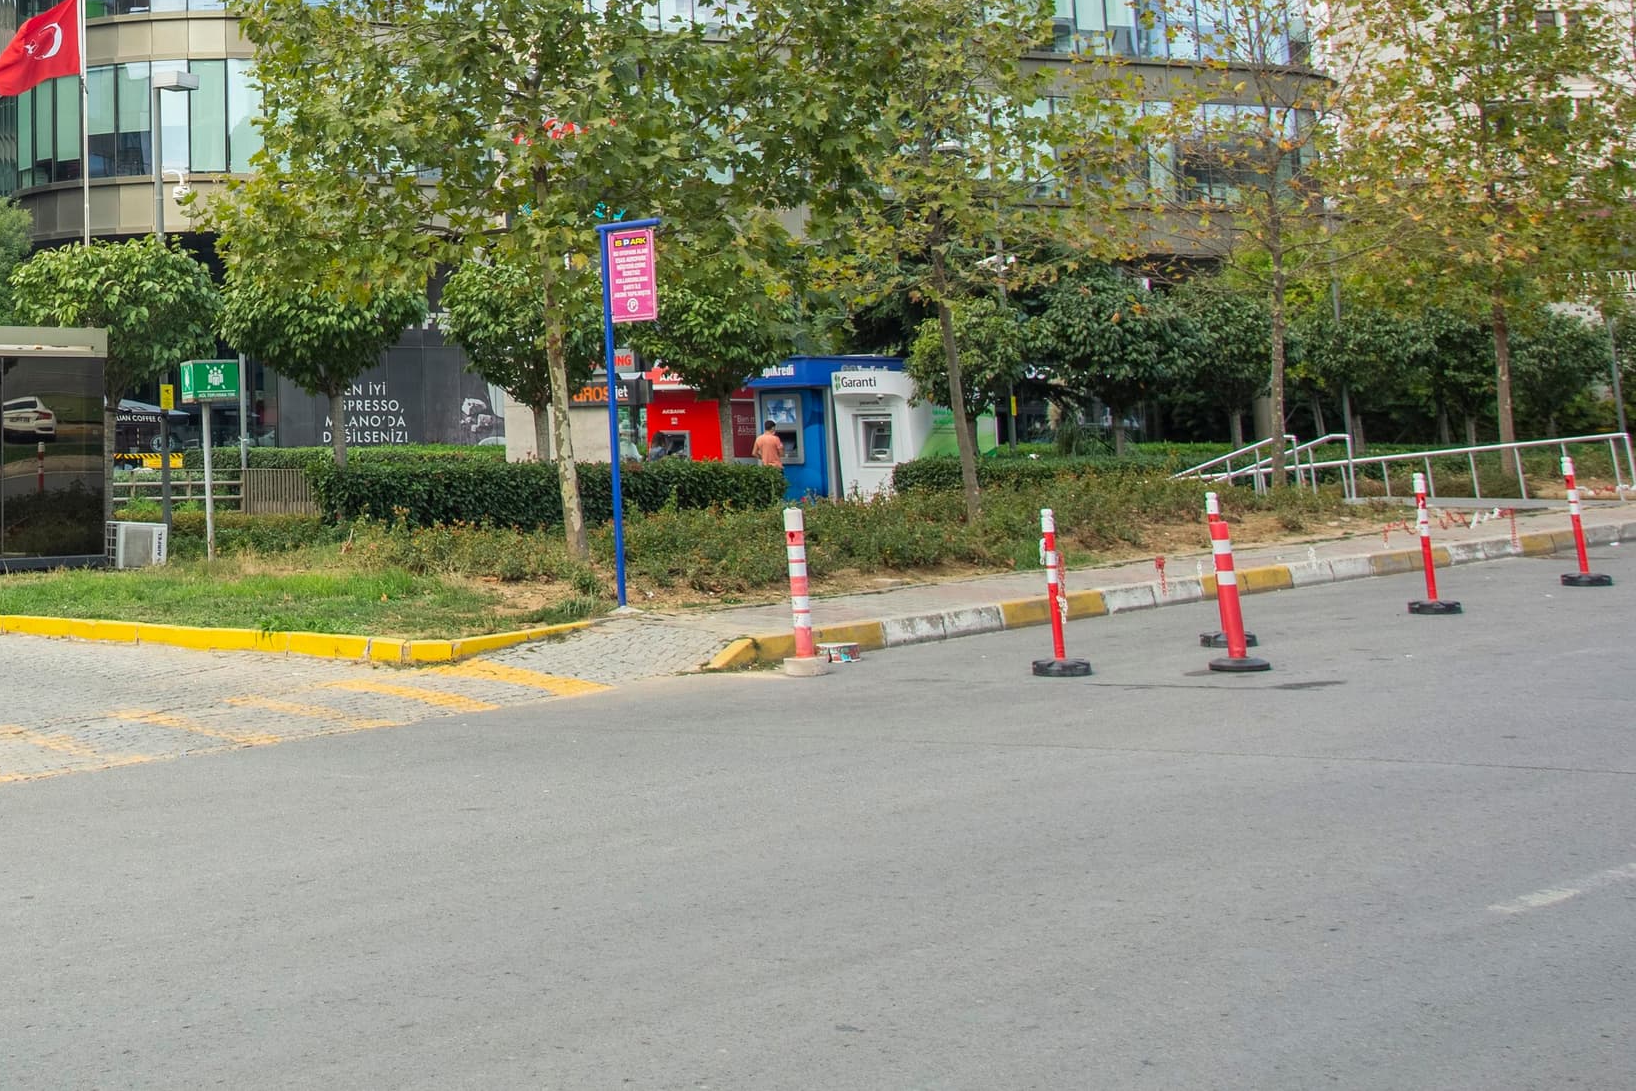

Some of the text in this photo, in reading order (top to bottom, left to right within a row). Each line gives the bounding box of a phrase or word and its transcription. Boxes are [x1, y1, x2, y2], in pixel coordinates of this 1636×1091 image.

[369, 381, 386, 396] İYİ
[841, 376, 876, 388] Garanti
[323, 428, 408, 443] DĞİLSENİZ!
